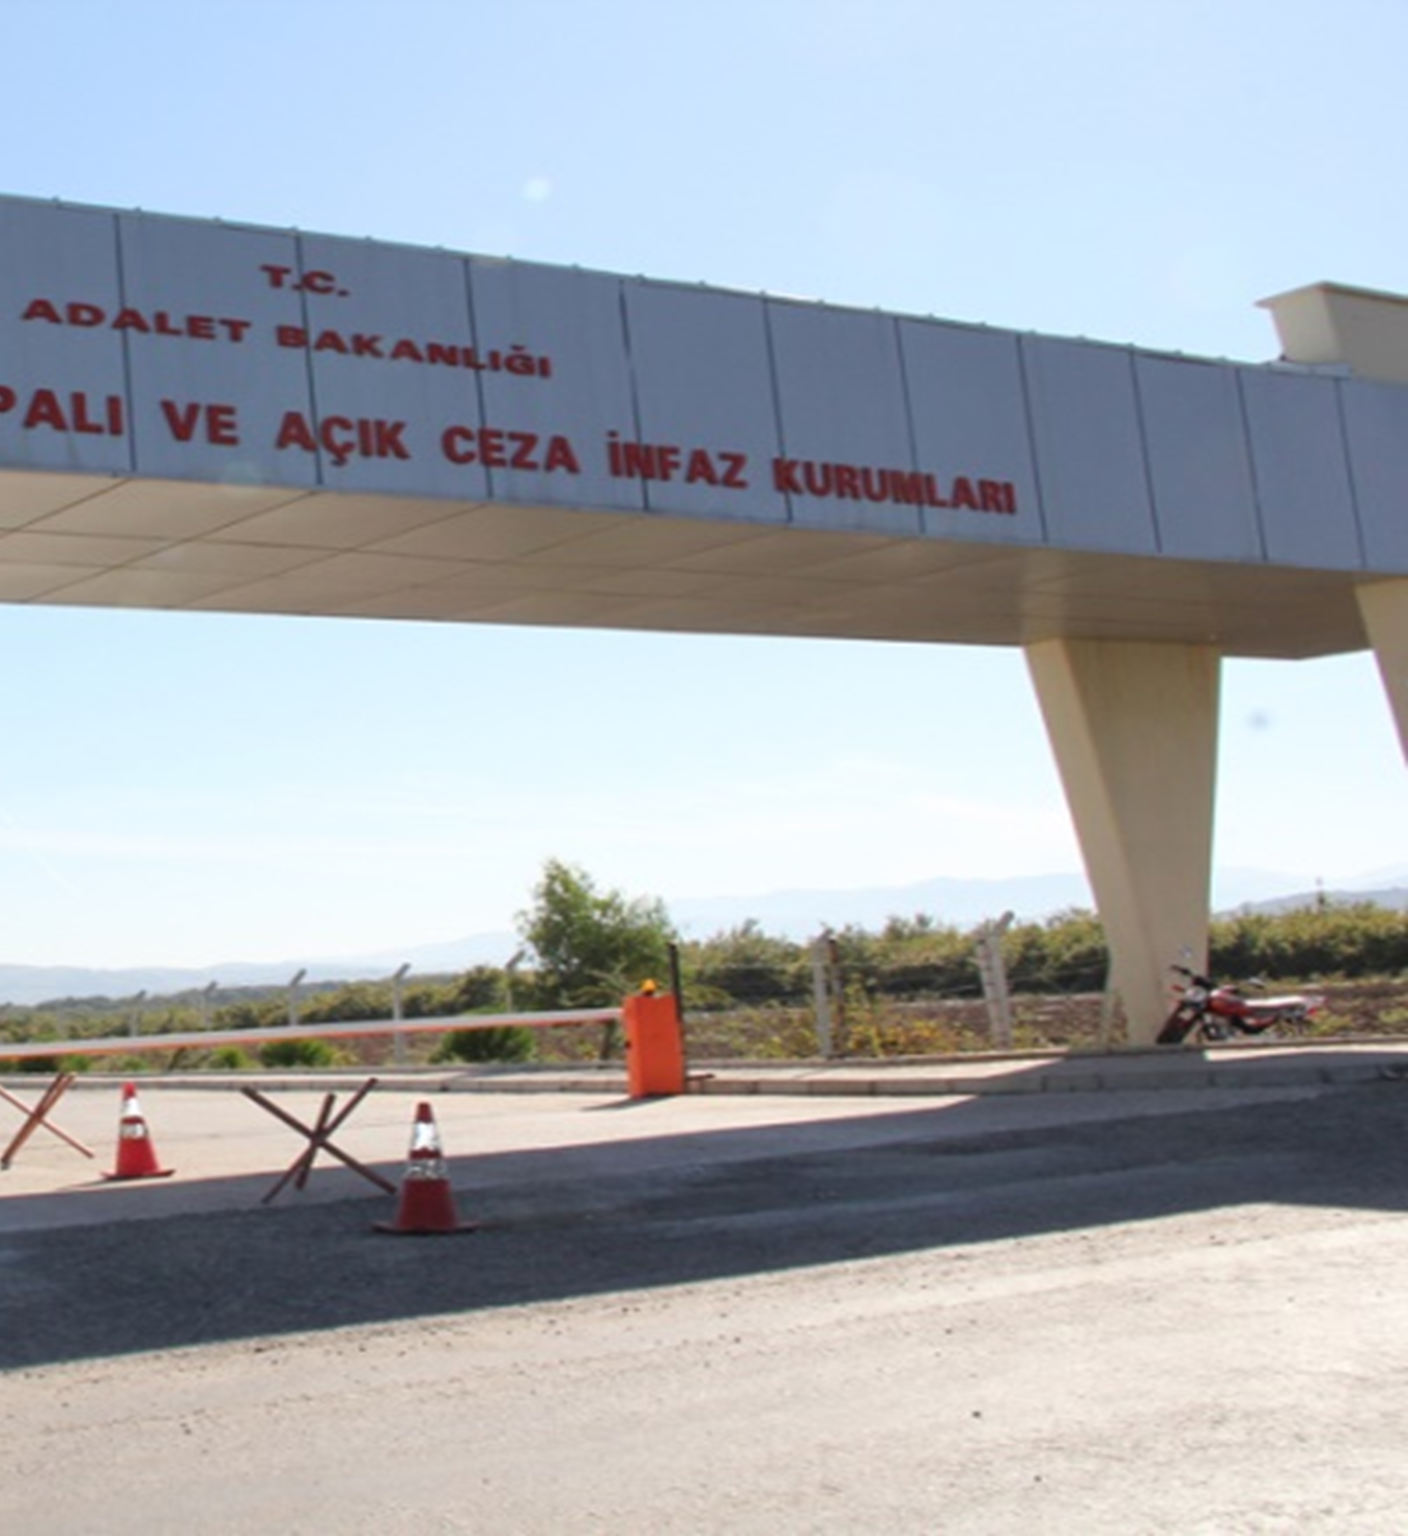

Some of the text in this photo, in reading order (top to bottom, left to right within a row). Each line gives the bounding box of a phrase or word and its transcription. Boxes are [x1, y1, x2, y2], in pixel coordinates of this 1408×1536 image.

[22, 298, 552, 379] ADALET BAKANLIĞI
[161, 400, 238, 446] VE
[276, 411, 410, 467] AÇIK
[441, 426, 580, 474] CEZA
[607, 430, 748, 489] İNFAZ
[772, 457, 1018, 515] KURUMLARI
